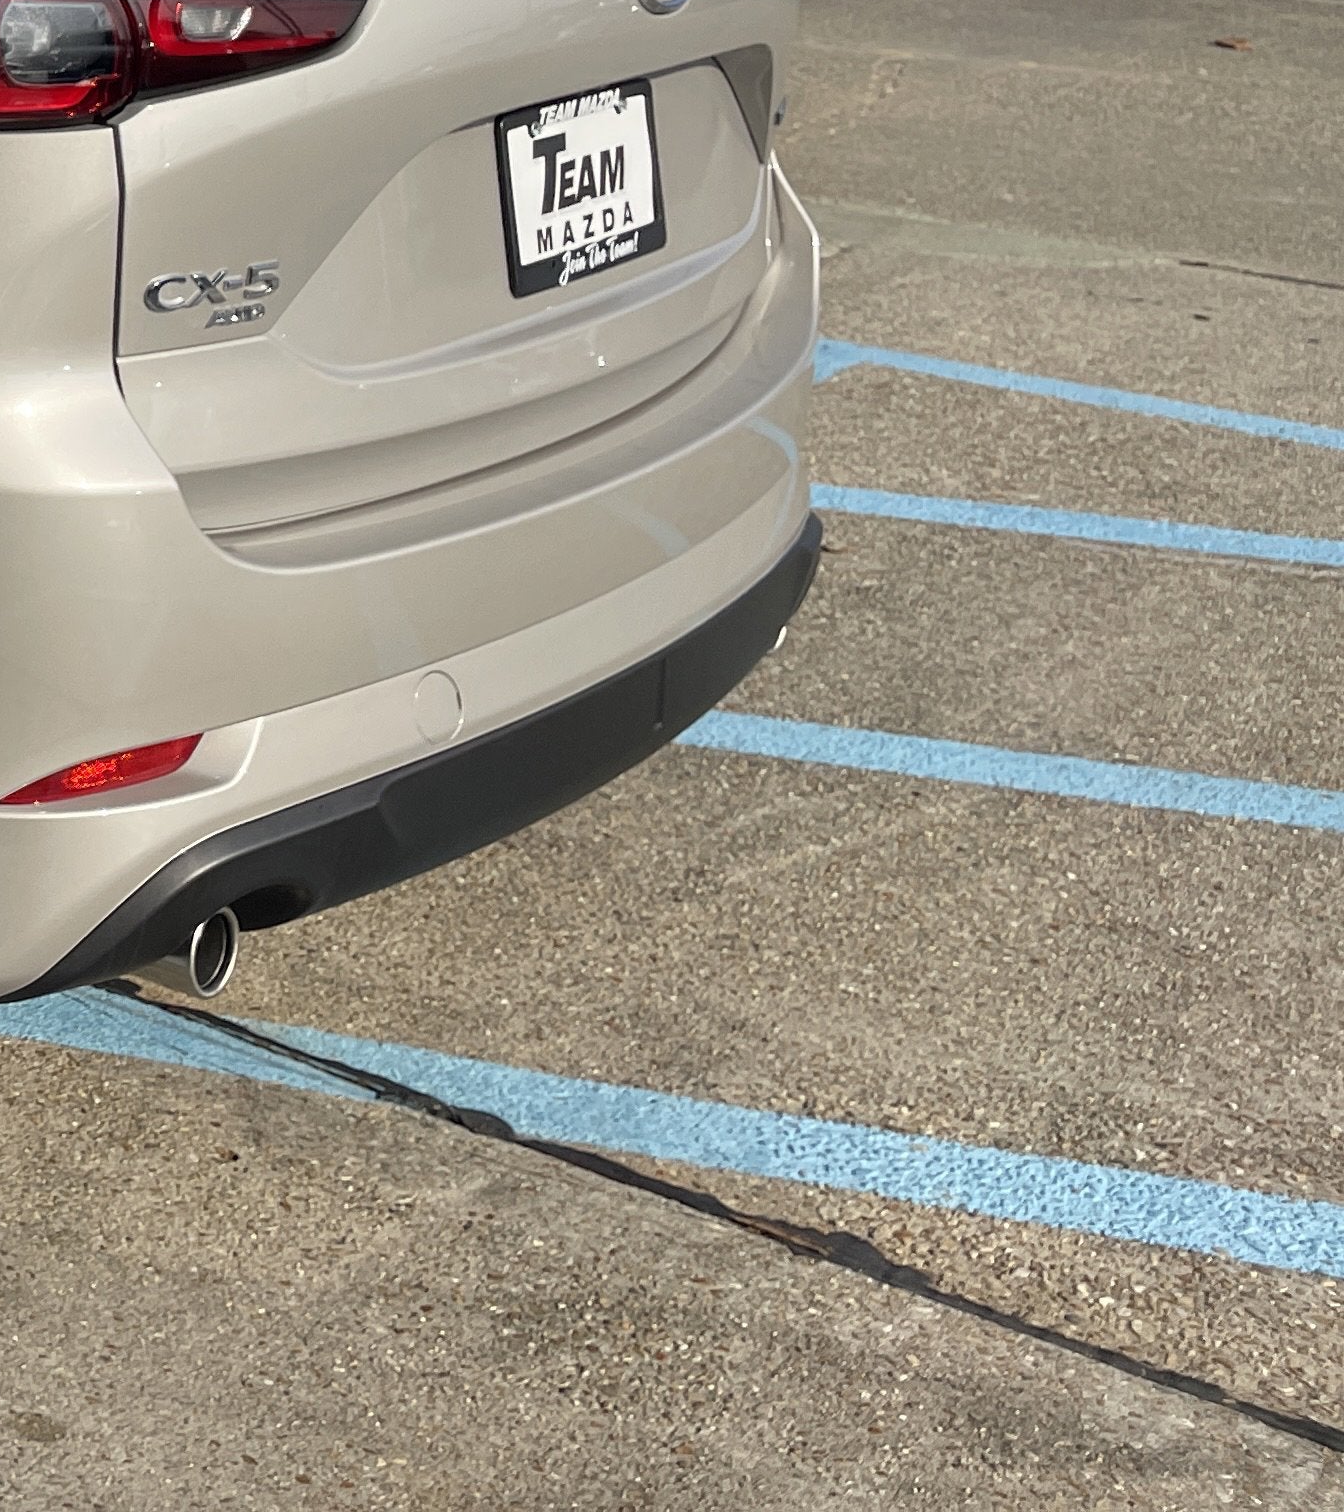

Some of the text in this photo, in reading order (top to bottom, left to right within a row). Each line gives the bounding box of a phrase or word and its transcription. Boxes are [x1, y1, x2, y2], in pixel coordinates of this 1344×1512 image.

[539, 88, 621, 126] TEAM MAZDA
[532, 132, 625, 215] TEAM
[537, 201, 633, 254] MAZDA
[143, 259, 280, 313] CX-5
[559, 250, 587, 286] Join
